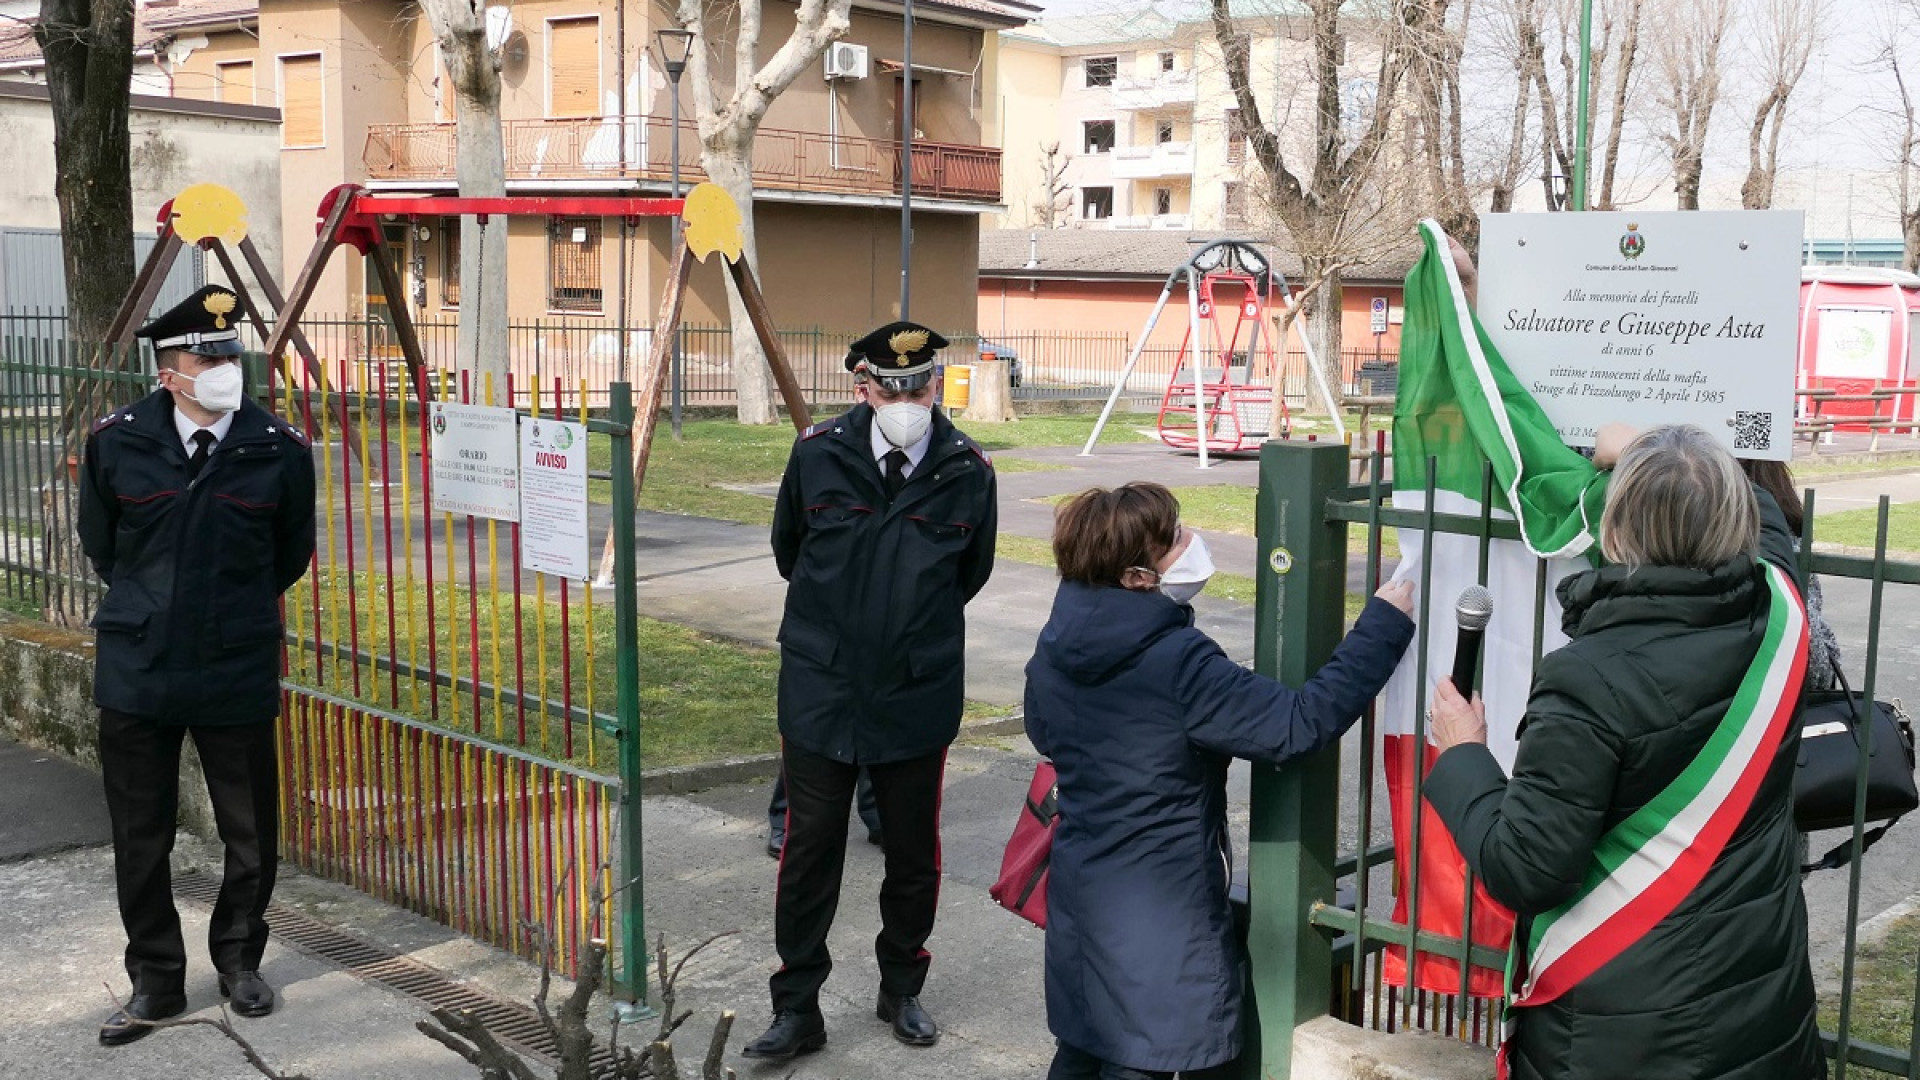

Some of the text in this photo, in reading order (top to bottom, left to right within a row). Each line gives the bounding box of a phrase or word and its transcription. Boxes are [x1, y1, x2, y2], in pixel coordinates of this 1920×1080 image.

[1585, 263, 1610, 271] Comune
[1611, 263, 1617, 271] di
[1618, 263, 1637, 271] Castel
[1563, 288, 1699, 307] Alla memoria dei fratelli
[1504, 308, 1765, 344] Salvatore e Giuseppe Asta
[1601, 342, 1655, 356] di anni 6
[1549, 364, 1708, 387] vittime innocenti della mafia
[1531, 381, 1726, 403] Strage di Pizzolungo 2 Aprile 1985
[1569, 426, 1581, 436] 12
[459, 449, 487, 461] ORARIO
[535, 451, 567, 470] AVVISO
